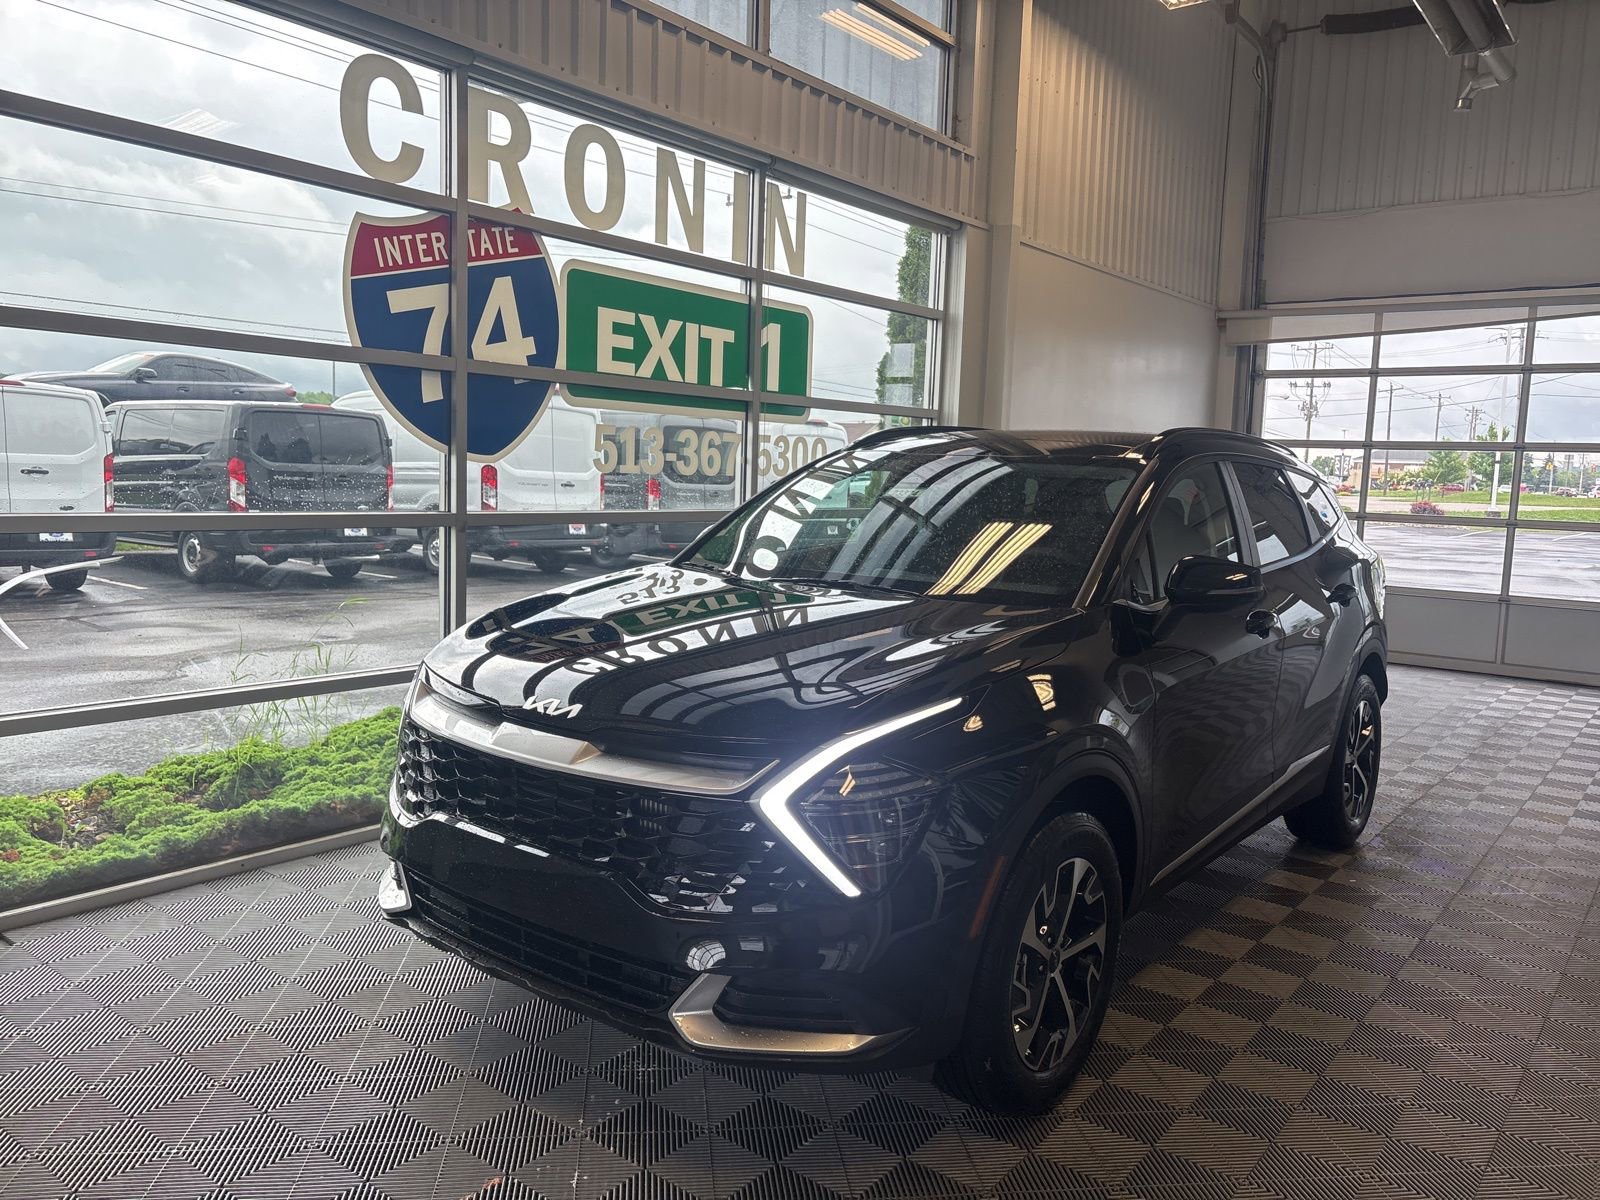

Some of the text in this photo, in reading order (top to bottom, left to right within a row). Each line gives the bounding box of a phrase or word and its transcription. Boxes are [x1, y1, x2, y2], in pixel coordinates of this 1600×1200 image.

[339, 53, 807, 278] CRONIN
[373, 226, 519, 268] INTERTATE
[386, 275, 537, 404] 74
[596, 306, 781, 392] EXIT 1
[593, 423, 828, 477] 513-3675300
[522, 694, 584, 719] KIA
